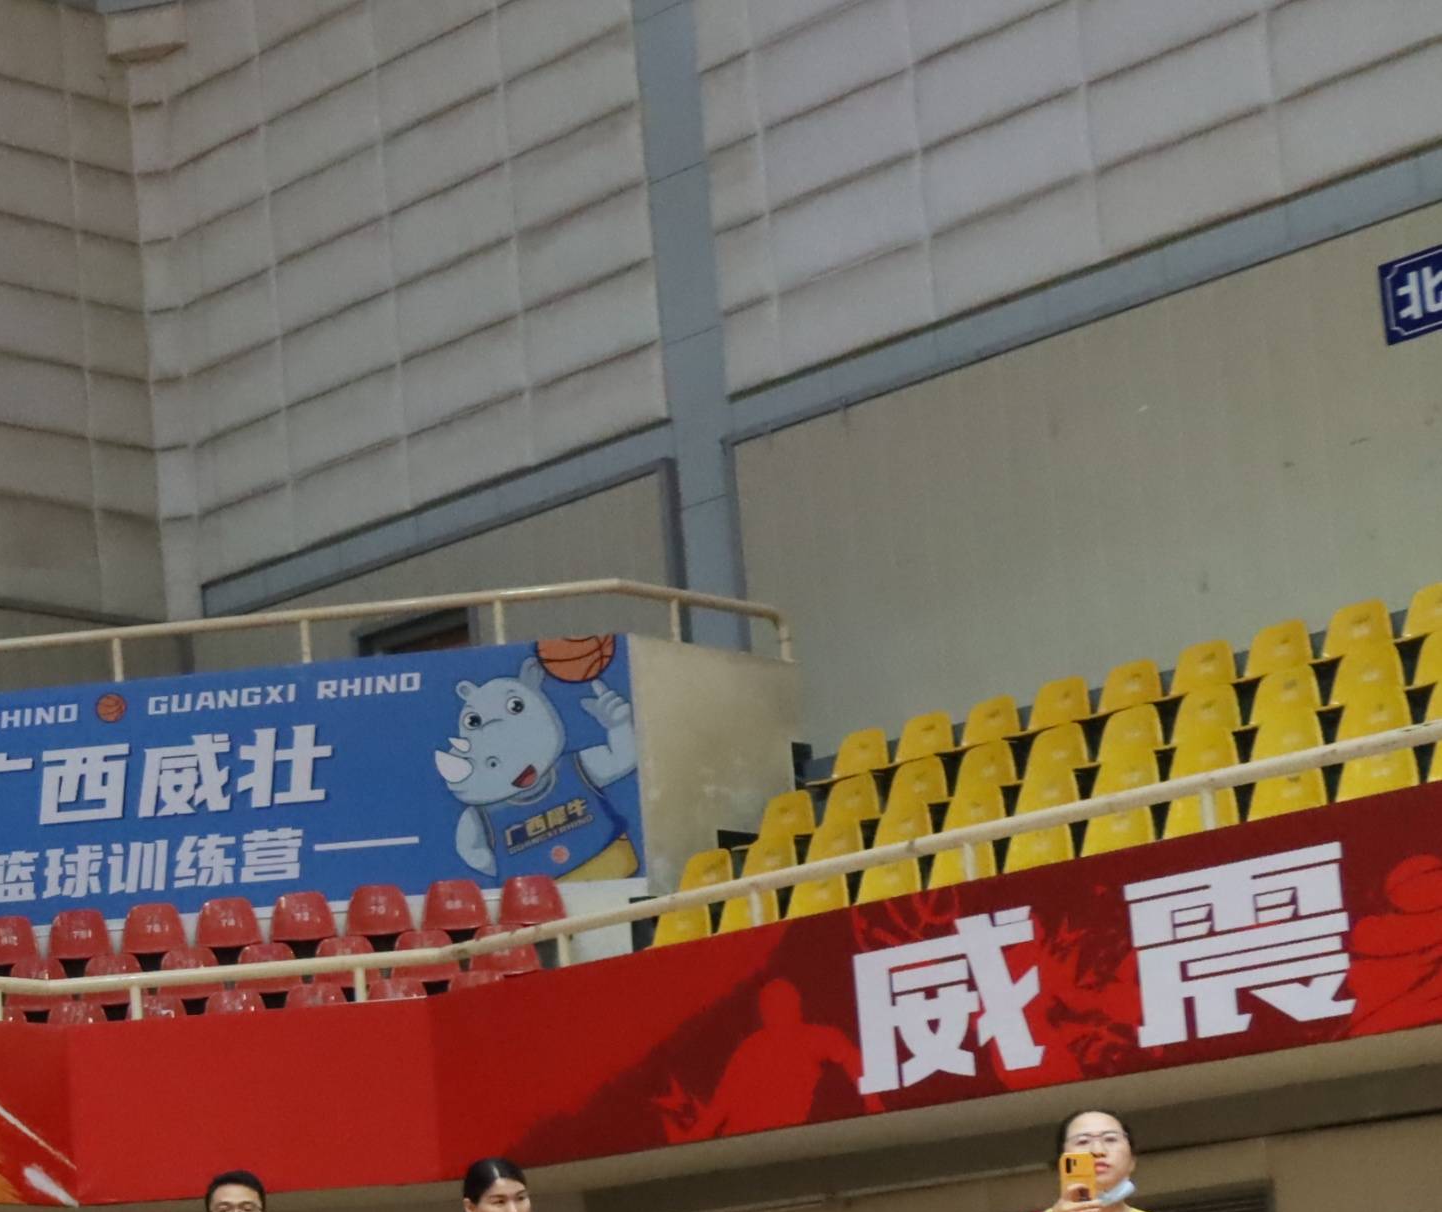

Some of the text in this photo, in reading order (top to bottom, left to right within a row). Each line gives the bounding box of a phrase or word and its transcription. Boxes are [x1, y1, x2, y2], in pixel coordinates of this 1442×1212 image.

[1397, 266, 1442, 320] 北
[148, 683, 296, 716] GUANGXI
[317, 672, 421, 700] RHINO
[854, 842, 1356, 1095] 威震
